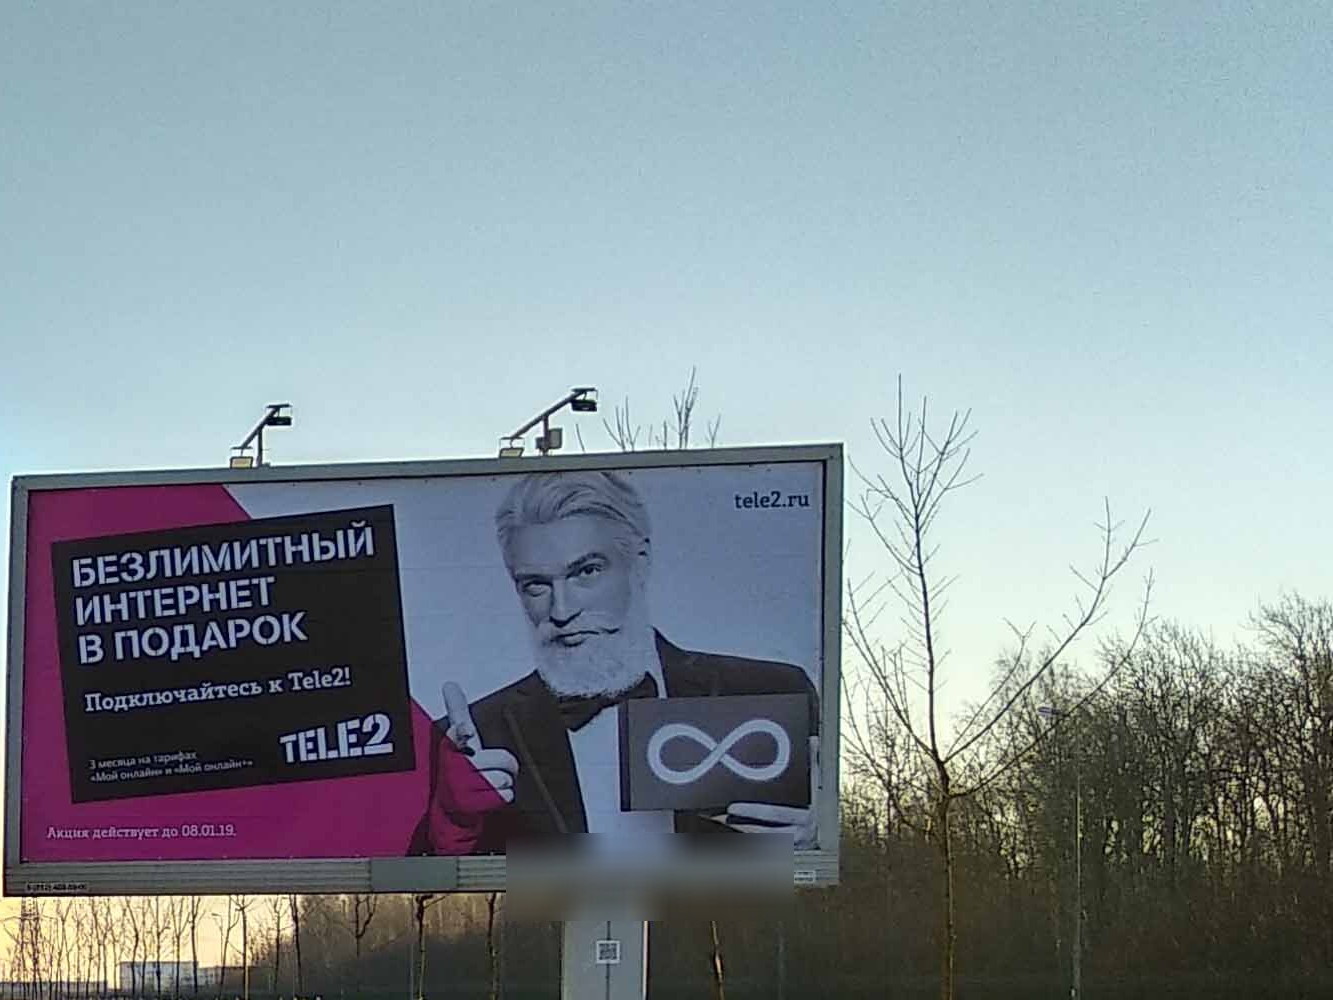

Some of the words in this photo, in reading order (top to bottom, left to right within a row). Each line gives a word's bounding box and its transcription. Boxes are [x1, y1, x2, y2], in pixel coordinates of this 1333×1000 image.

[734, 491, 810, 509] tele2.ru
[72, 520, 375, 588] БЕЗЛИМИТНЫЙ
[74, 576, 276, 626] ИНТЕРНЕТ
[78, 634, 105, 664] В
[114, 611, 309, 661] ПОДАРОК
[84, 678, 263, 712] Подключайтесь
[269, 678, 283, 694] к
[287, 667, 352, 691] Tele2!
[89, 760, 97, 770] 3
[98, 757, 136, 769] месяца
[138, 756, 151, 765] на
[153, 751, 198, 766] тарифах
[279, 713, 394, 763] TELE2
[165, 767, 172, 776] и
[46, 826, 89, 840] Акция
[92, 826, 159, 842] действует
[161, 827, 179, 839] до
[181, 824, 237, 838] 08.01.19.
